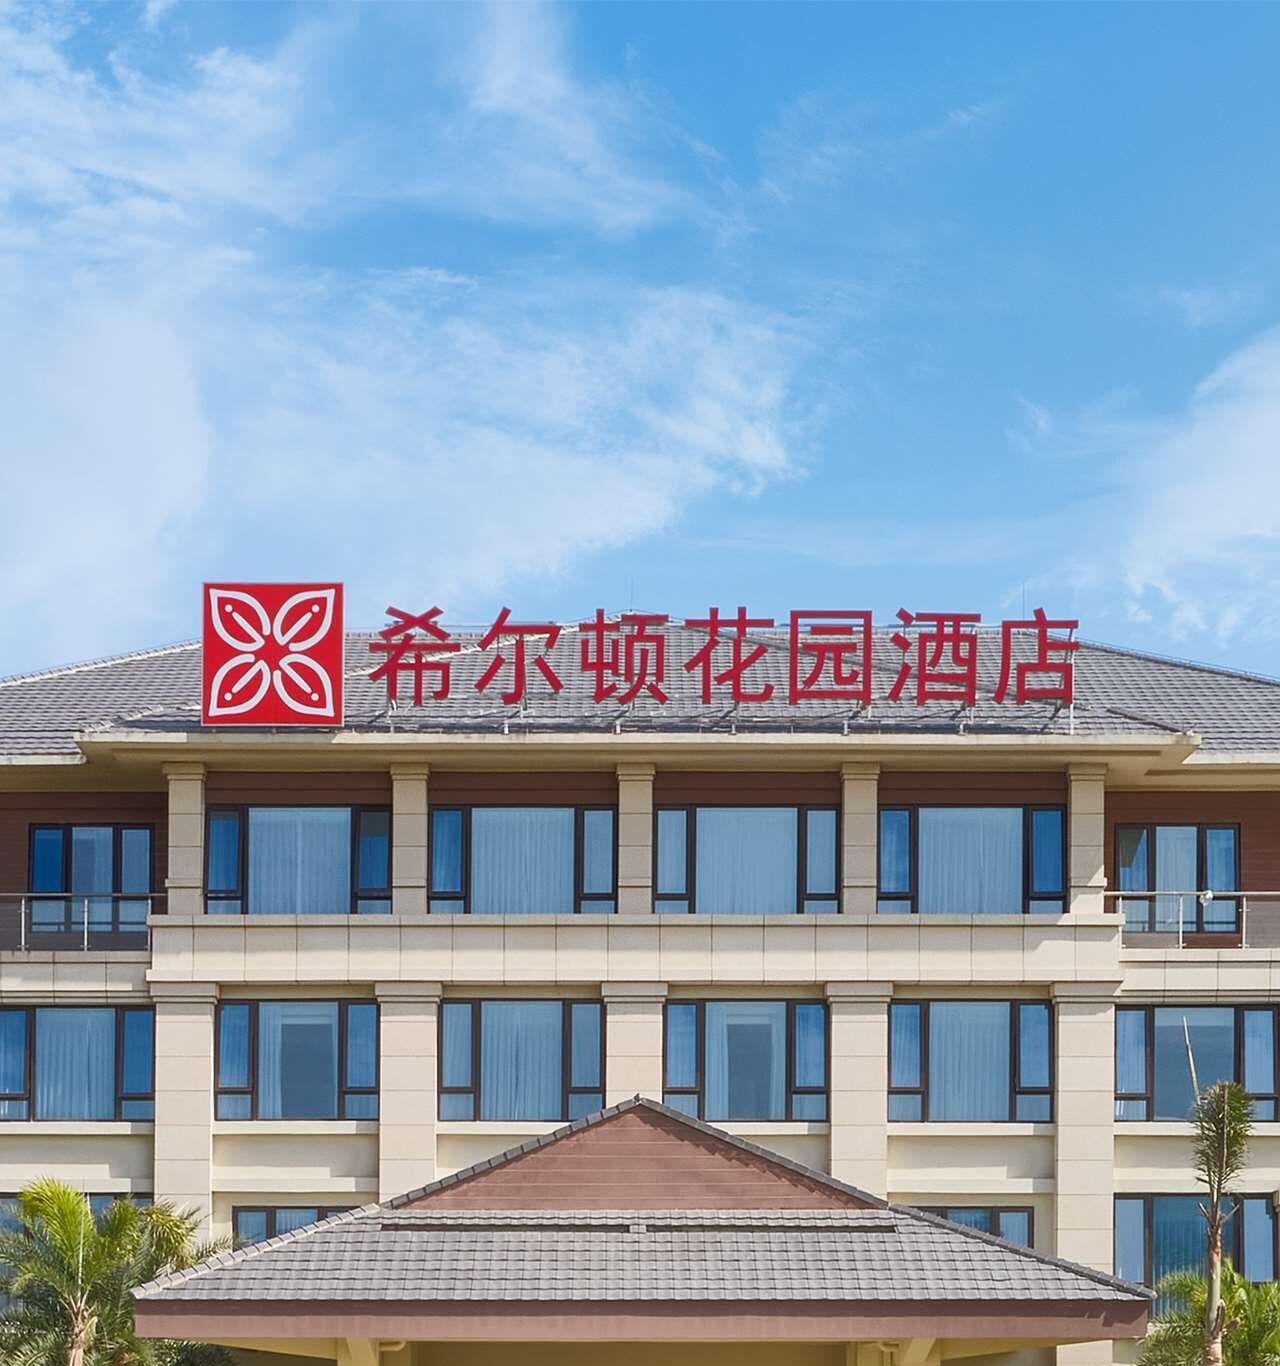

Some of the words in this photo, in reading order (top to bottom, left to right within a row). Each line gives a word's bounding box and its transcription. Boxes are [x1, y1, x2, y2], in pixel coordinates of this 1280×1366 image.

[368, 605, 1078, 707] 希尔顿花园酒店
